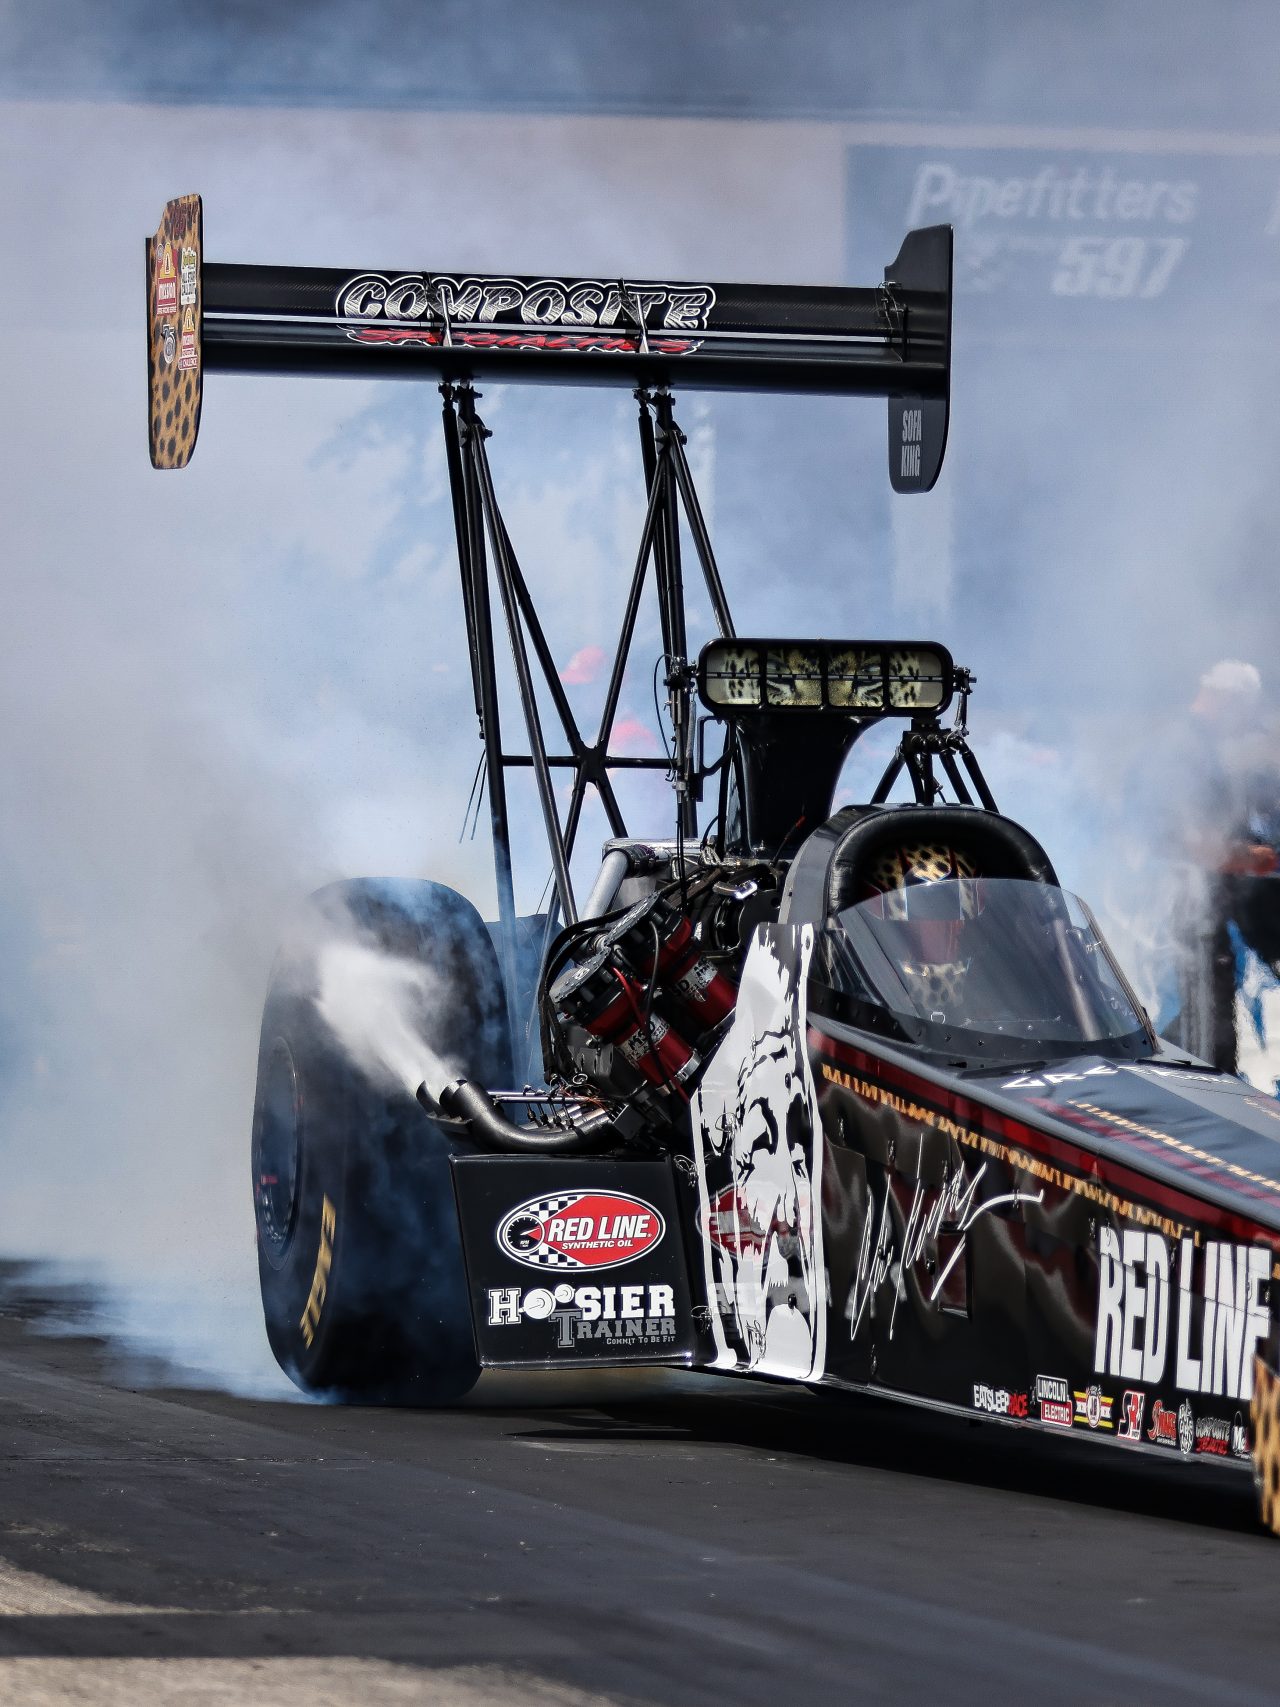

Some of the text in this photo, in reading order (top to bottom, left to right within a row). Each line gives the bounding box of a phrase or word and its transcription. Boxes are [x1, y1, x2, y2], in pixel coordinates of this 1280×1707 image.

[1052, 237, 1187, 298] 597
[344, 281, 708, 329] COMPOSITE
[902, 410, 922, 442] SOFA
[901, 445, 921, 477] KING
[547, 1213, 651, 1242] RED LINE
[561, 1239, 634, 1250] SYNTHETIC OIL
[548, 1308, 677, 1348] TRAINER
[1094, 1225, 1170, 1384] RED
[1175, 1237, 1272, 1400] LINE
[1037, 1379, 1067, 1402] LINCOLN
[1044, 1403, 1070, 1423] ELECTRIC
